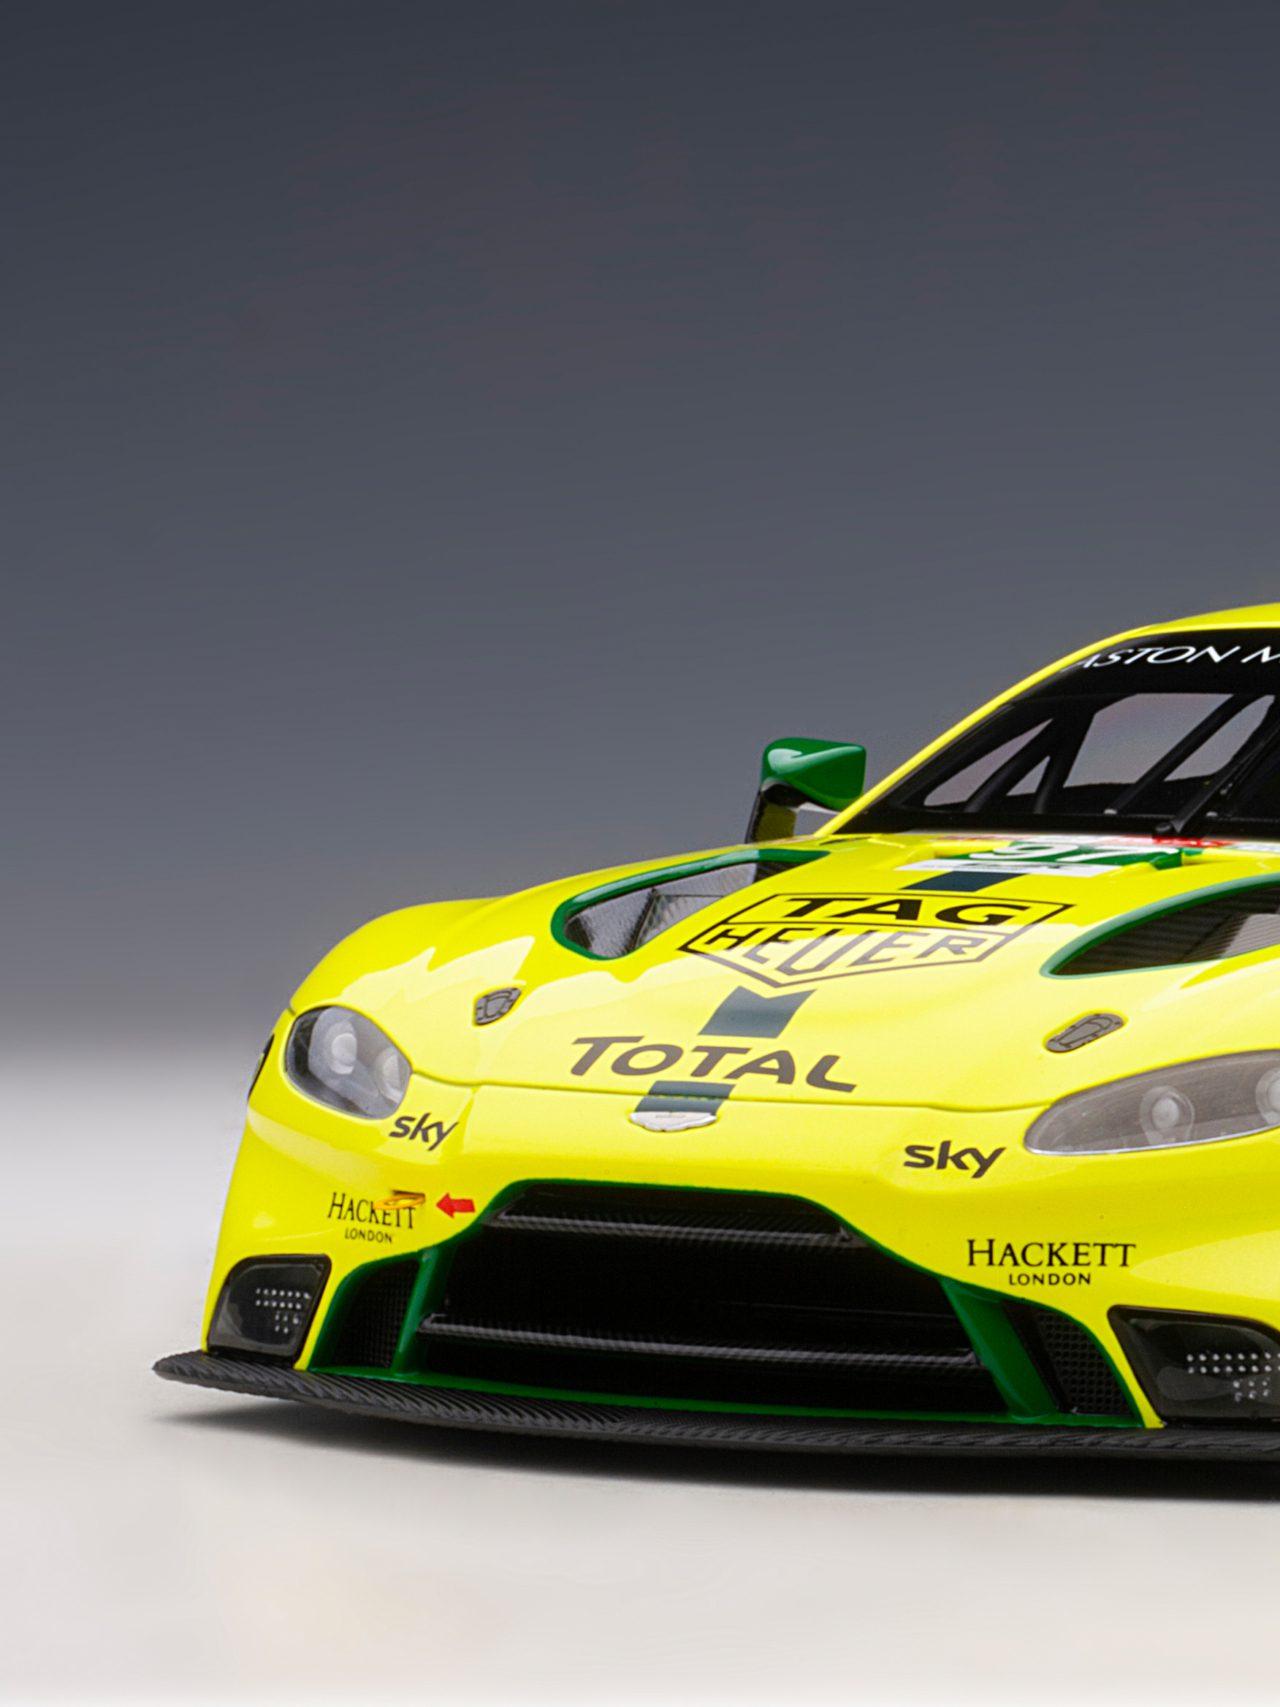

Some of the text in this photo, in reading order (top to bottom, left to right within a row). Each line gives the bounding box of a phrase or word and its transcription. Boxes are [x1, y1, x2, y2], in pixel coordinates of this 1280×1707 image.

[782, 897, 1031, 926] TAG
[704, 928, 988, 976] HEUER
[571, 1036, 857, 1093] TOTAL
[389, 1112, 458, 1151] sky
[903, 1140, 1007, 1179] sky
[345, 1228, 393, 1244] LONDON
[967, 1238, 1137, 1269] HACKETT
[1008, 1273, 1092, 1286] LONDON
